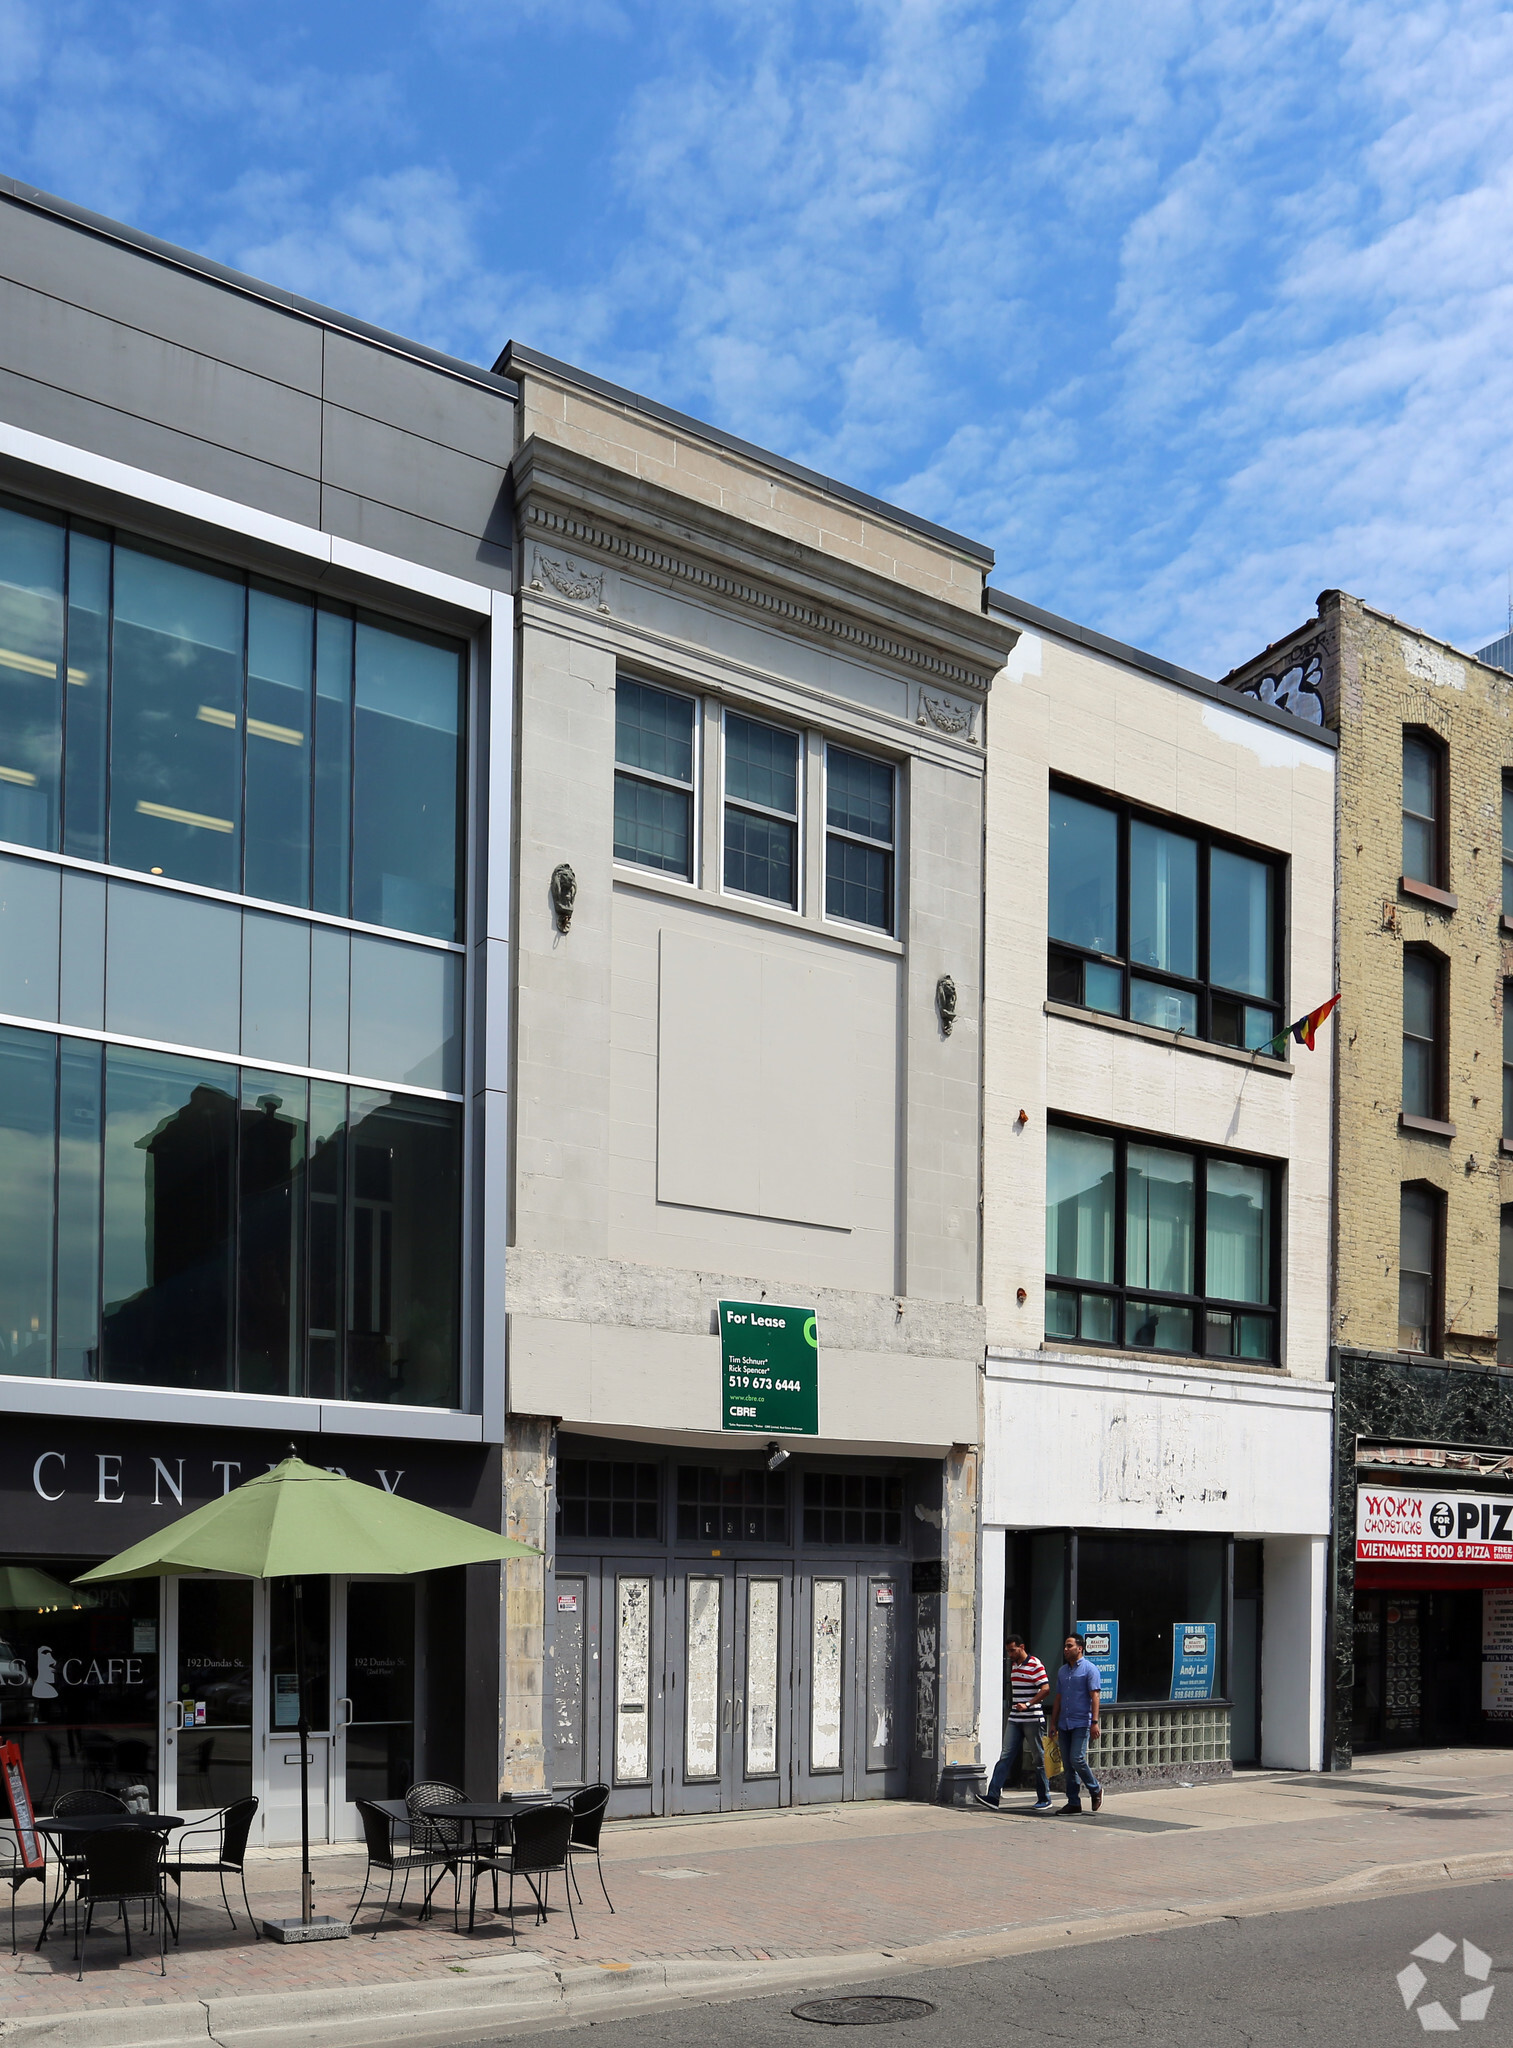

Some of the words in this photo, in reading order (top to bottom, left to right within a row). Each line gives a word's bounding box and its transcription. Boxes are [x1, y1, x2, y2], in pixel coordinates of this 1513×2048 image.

[727, 1310, 747, 1324] For
[750, 1312, 786, 1328] Lease
[728, 1355, 740, 1363] Tim
[728, 1364, 741, 1372] Rick
[729, 1375, 750, 1388] 519
[752, 1377, 772, 1390] 673
[775, 1379, 801, 1392] 6444
[729, 1394, 765, 1403] www.cbre.ca
[729, 1406, 757, 1417] CBRE
[1365, 1495, 1423, 1518] WOK'N
[1435, 1504, 1449, 1516] 2
[1433, 1516, 1450, 1524] FOR
[1364, 1519, 1423, 1536] CHOPSTICKS
[1437, 1525, 1447, 1537] 1
[1361, 1542, 1425, 1558] VIETNAMESE
[1425, 1544, 1455, 1558] FOOD
[1457, 1545, 1464, 1558] &
[1465, 1546, 1491, 1559] PIZZA
[1493, 1546, 1513, 1554] FREE
[1086, 1624, 1096, 1632] FOR
[1096, 1624, 1108, 1632] SALE
[1185, 1626, 1194, 1634] FOR
[186, 1658, 202, 1667] 192
[203, 1658, 233, 1667] Dundas
[234, 1658, 244, 1668] St.
[354, 1658, 368, 1667] 192
[369, 1657, 396, 1667] Dundas
[62, 1658, 144, 1686] CAFE
[1180, 1665, 1196, 1677] Andy
